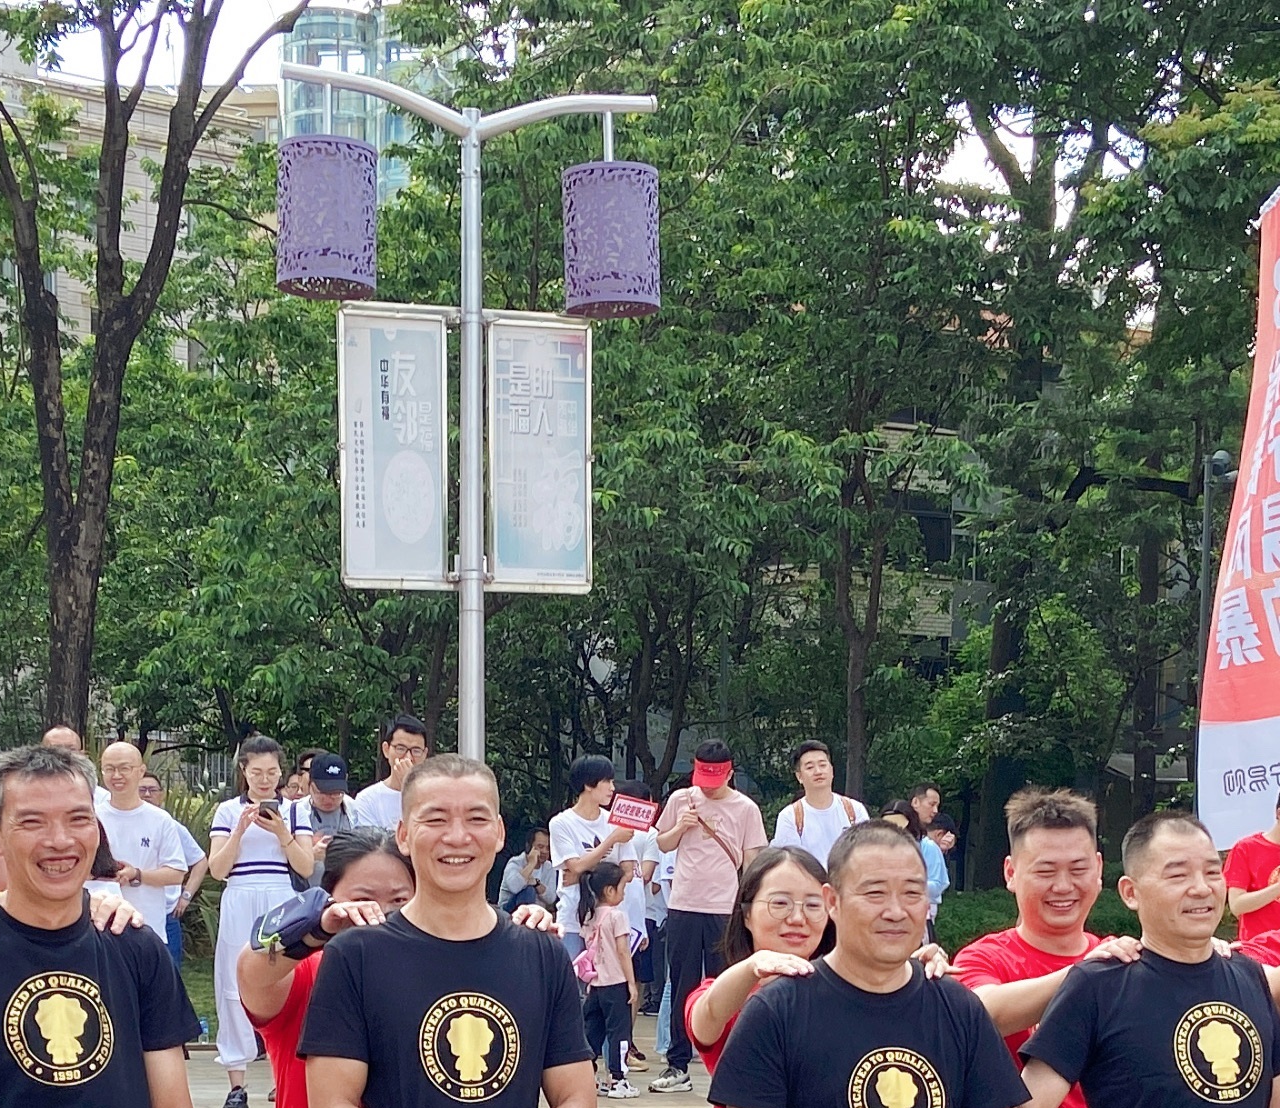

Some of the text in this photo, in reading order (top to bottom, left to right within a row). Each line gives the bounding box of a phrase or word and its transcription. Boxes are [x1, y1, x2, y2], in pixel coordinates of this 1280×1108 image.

[509, 360, 531, 435] 是福
[8, 990, 35, 1070] DEDICATED
[27, 978, 46, 993] TO
[423, 996, 517, 1084] DEDICATED TO QUALITY SERVICE
[1178, 1005, 1263, 1090] DEDICATED TO QUALITY SERVICE
[53, 1069, 81, 1082] 1990
[869, 1053, 884, 1066] TO
[885, 1051, 934, 1080] QUALITY
[460, 1087, 485, 1098] 1990
[1217, 1088, 1240, 1100] 1990
